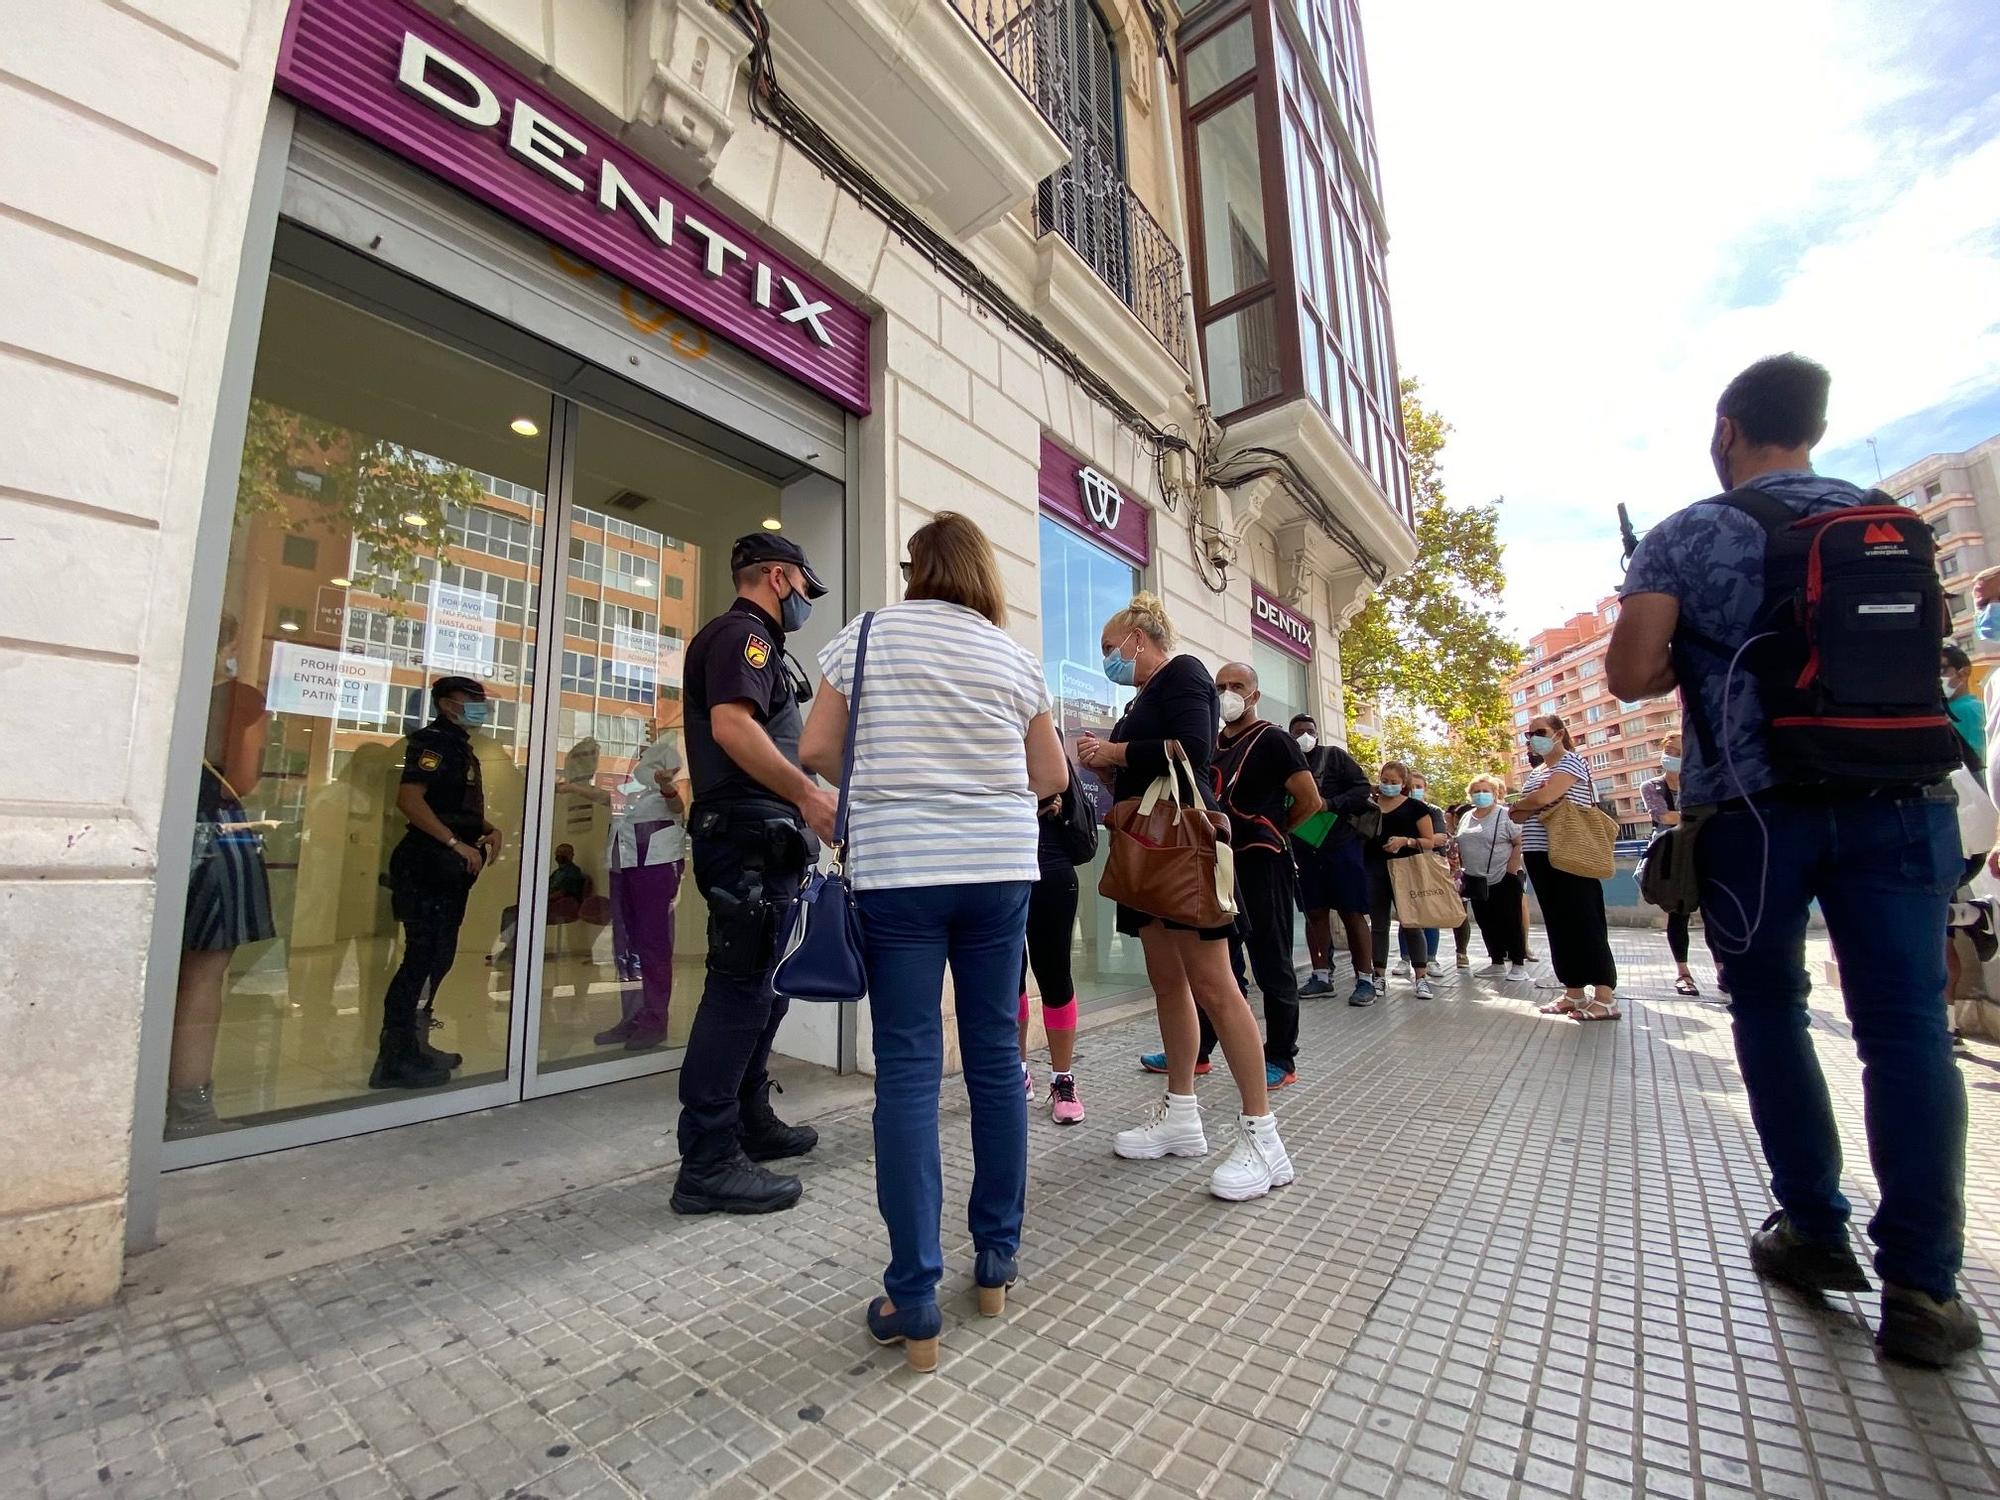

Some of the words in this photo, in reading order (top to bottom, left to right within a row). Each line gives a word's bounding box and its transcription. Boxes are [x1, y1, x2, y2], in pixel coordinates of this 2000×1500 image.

[399, 31, 834, 348] DENTIX
[439, 619, 465, 629] HASTA
[1256, 595, 1312, 649] DENTIX
[448, 642, 471, 651] AVISE
[300, 658, 366, 676] PROHIBIDO
[293, 673, 340, 687] ENTRAR
[343, 680, 369, 692] CON
[302, 689, 358, 704] PATINETE
